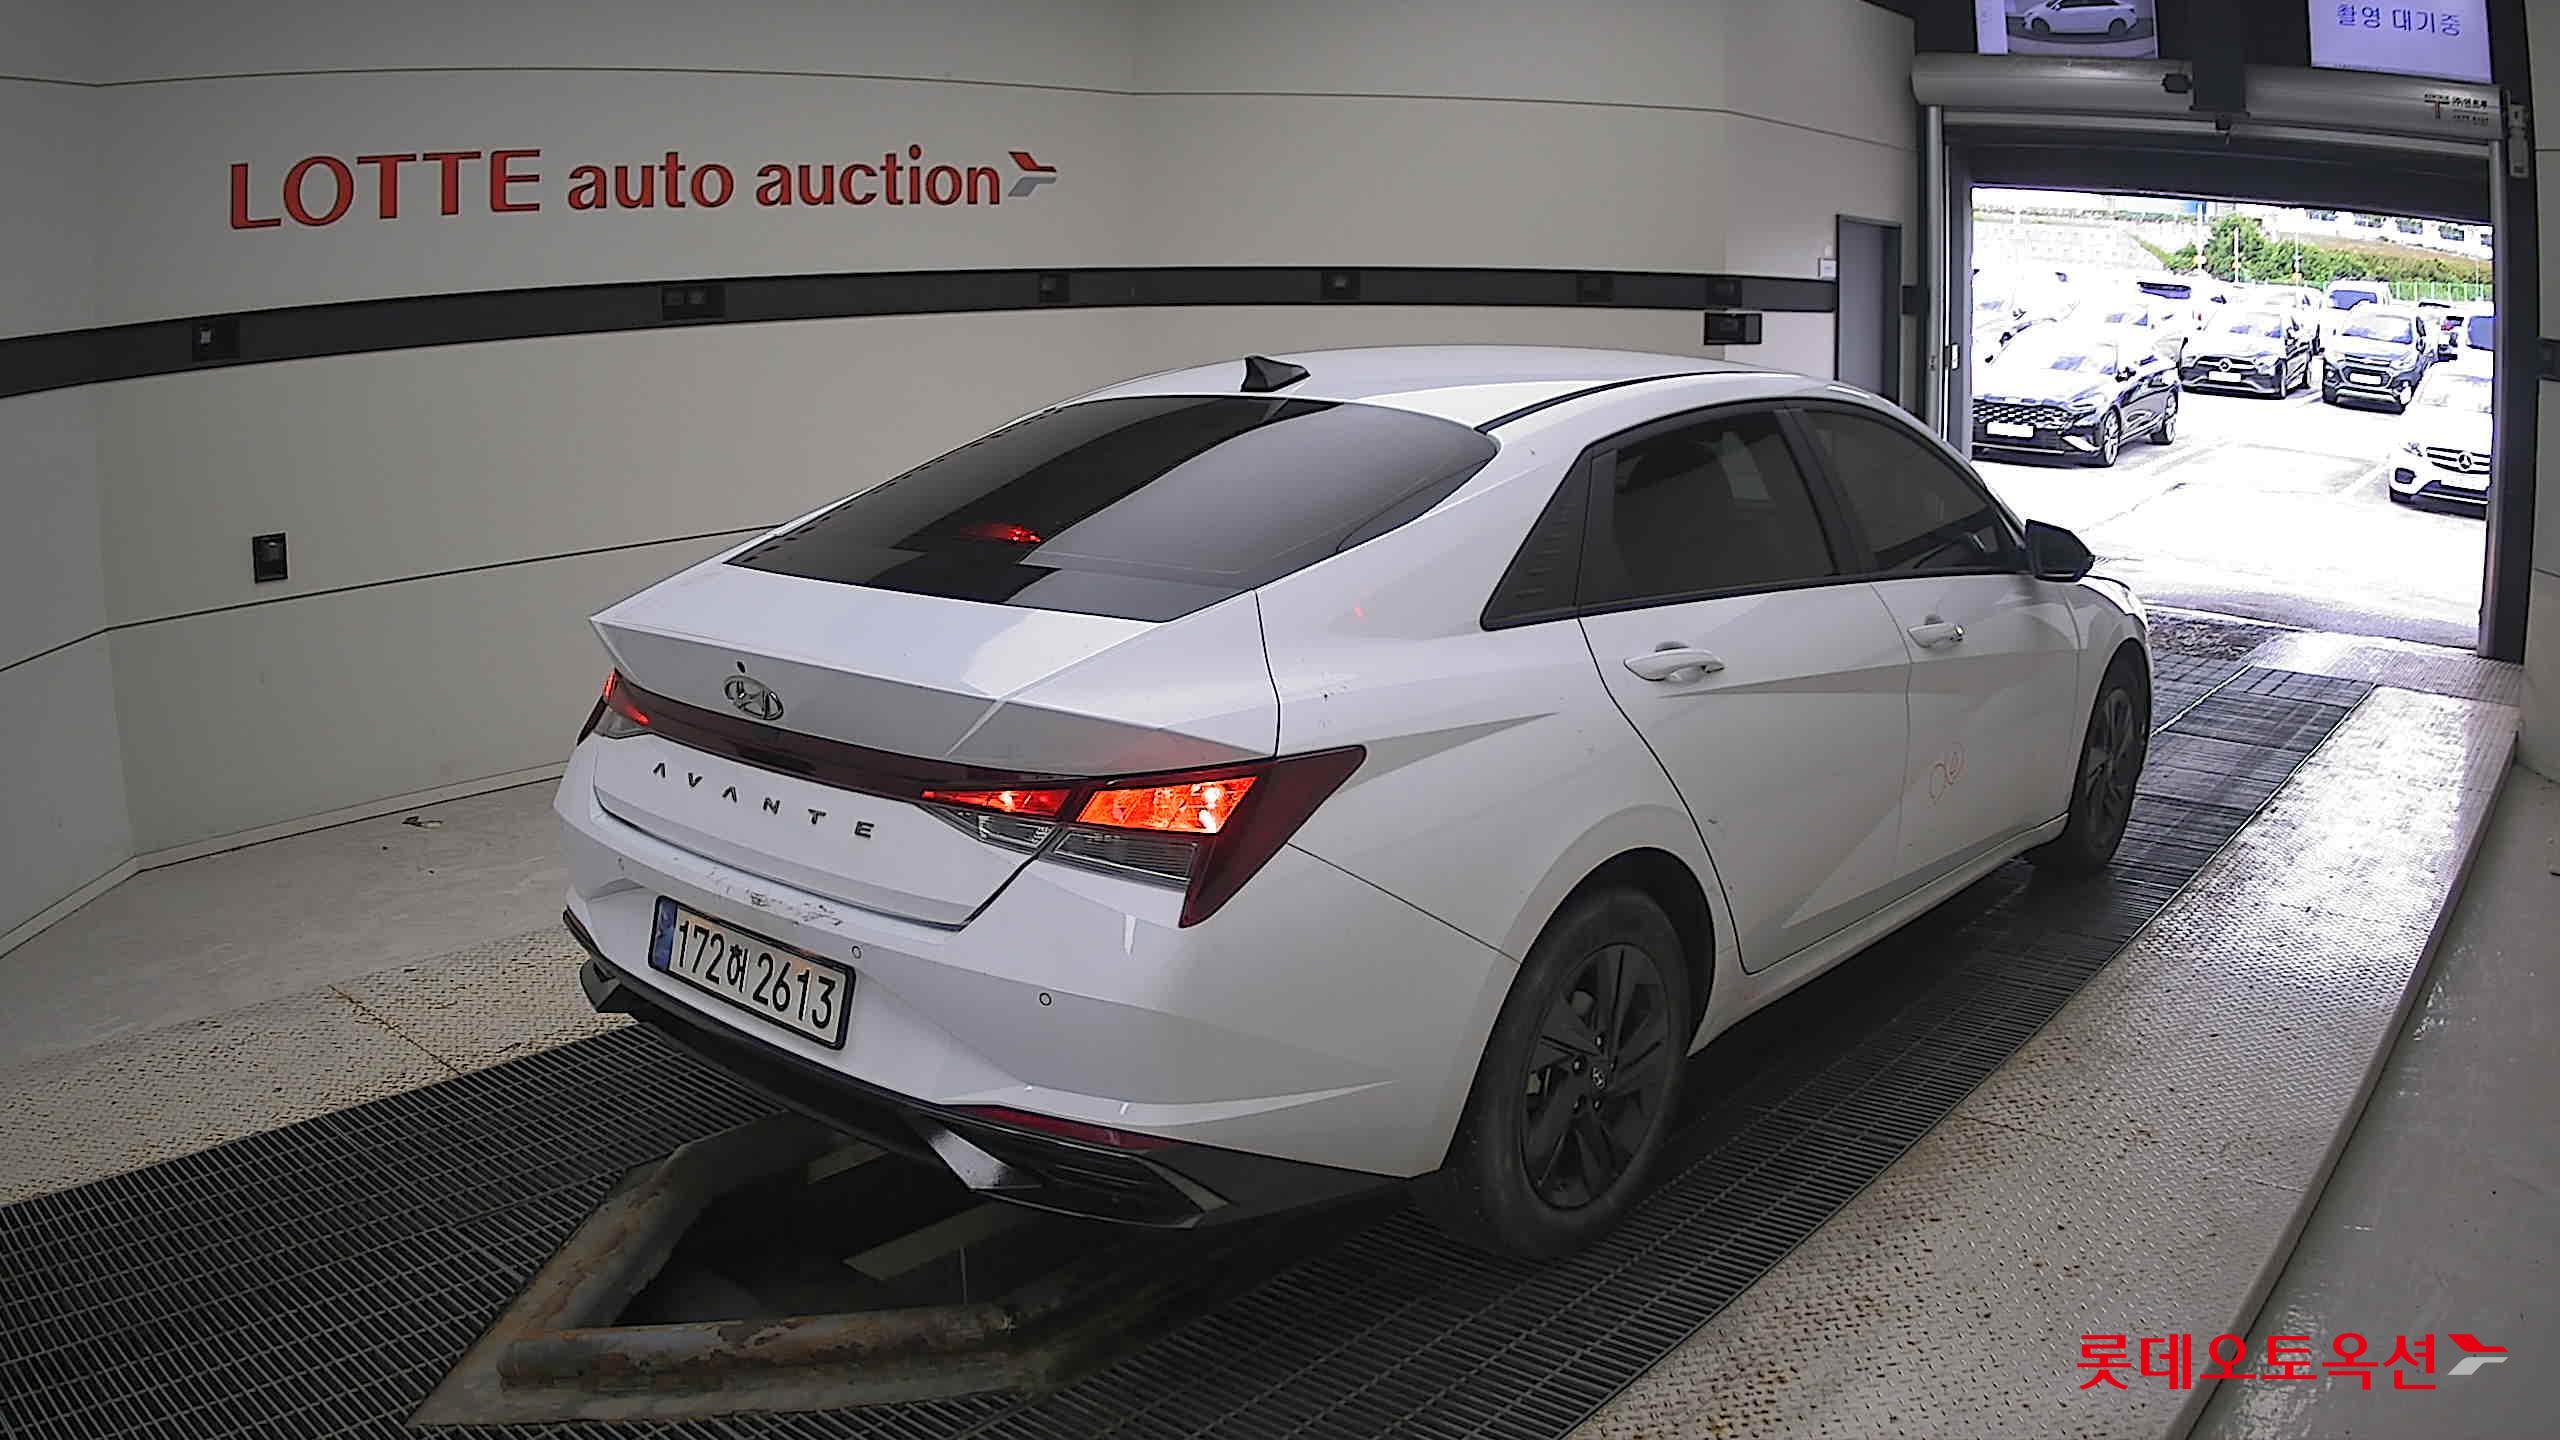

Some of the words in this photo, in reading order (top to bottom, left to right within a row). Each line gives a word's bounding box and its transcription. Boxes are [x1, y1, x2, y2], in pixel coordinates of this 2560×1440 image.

[2337, 4, 2380, 28] 촬영
[2392, 9, 2461, 37] 대기중
[230, 150, 541, 230] LOTTE
[567, 152, 736, 210] auto
[757, 146, 1002, 207] auction
[653, 762, 876, 839] AVANTE
